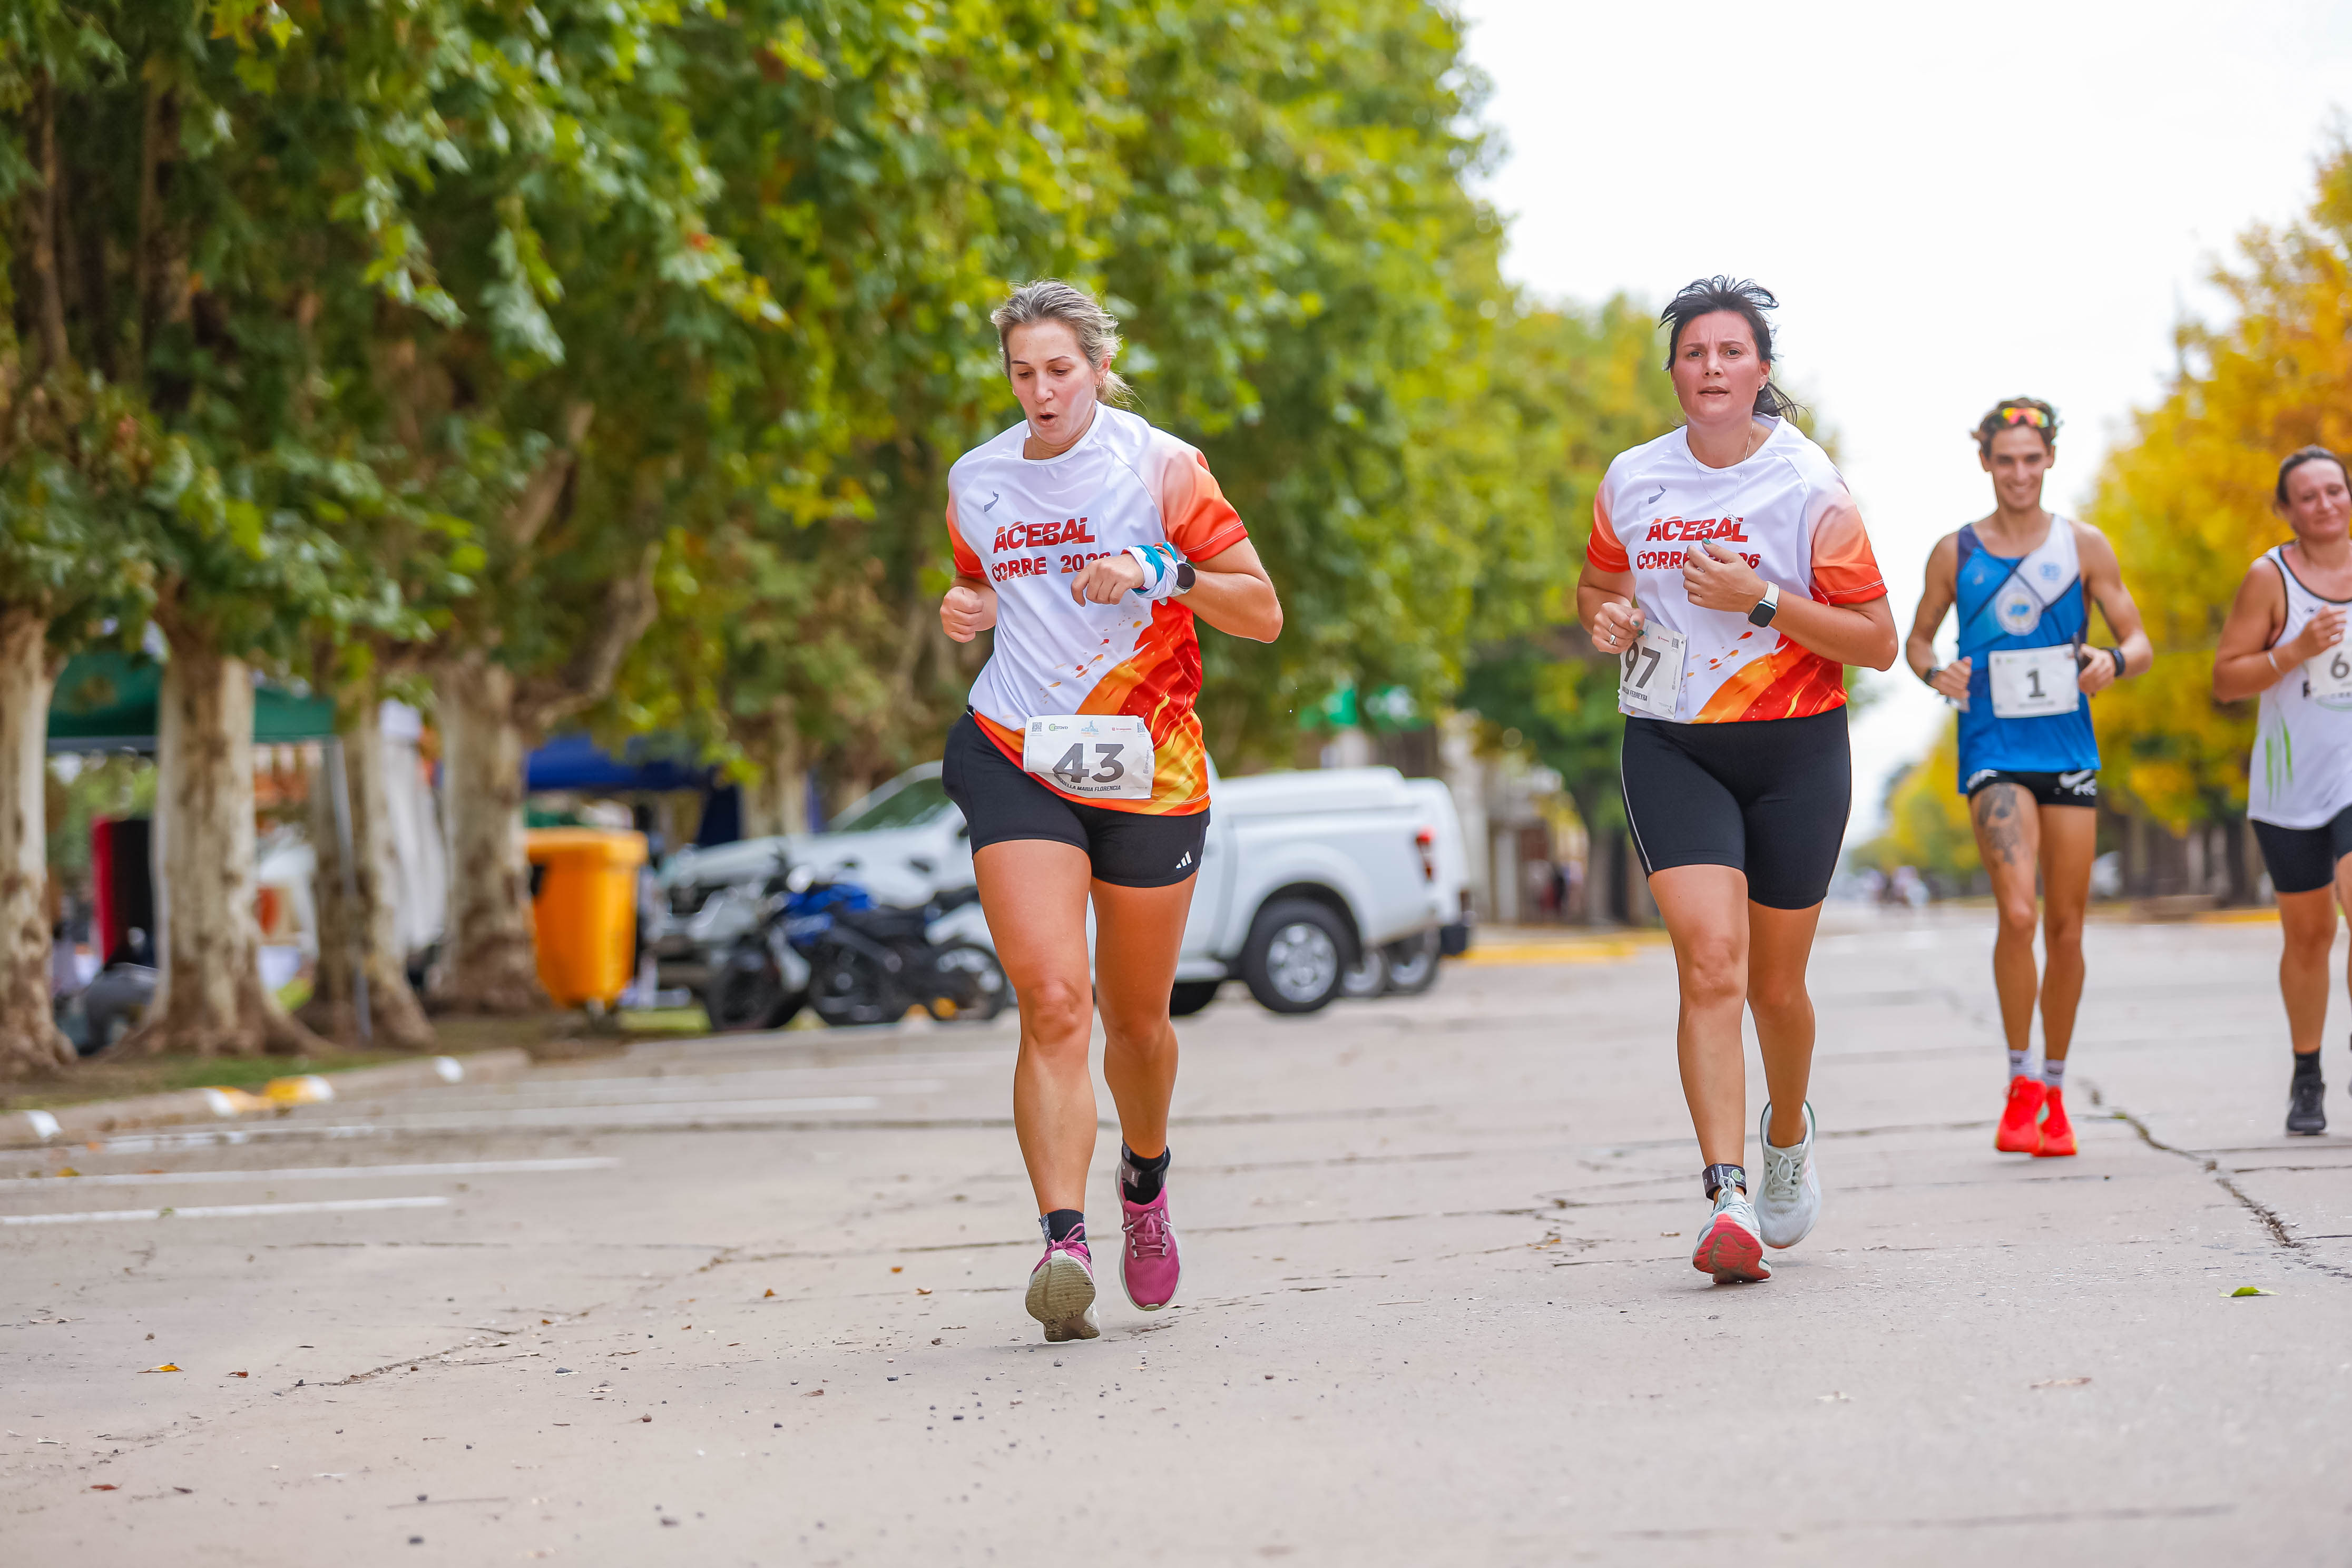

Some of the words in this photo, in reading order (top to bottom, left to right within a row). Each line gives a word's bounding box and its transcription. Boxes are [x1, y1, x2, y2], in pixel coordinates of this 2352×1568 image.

[993, 517, 1095, 553] ACEBAL
[1645, 516, 1748, 542] ACEBAL
[992, 556, 1047, 582] CORRE
[1624, 641, 1661, 689] 97
[2330, 652, 2350, 679] 6
[1630, 690, 1648, 701] FERREYRA
[2027, 669, 2045, 697] 1
[1052, 743, 1124, 783] 43
